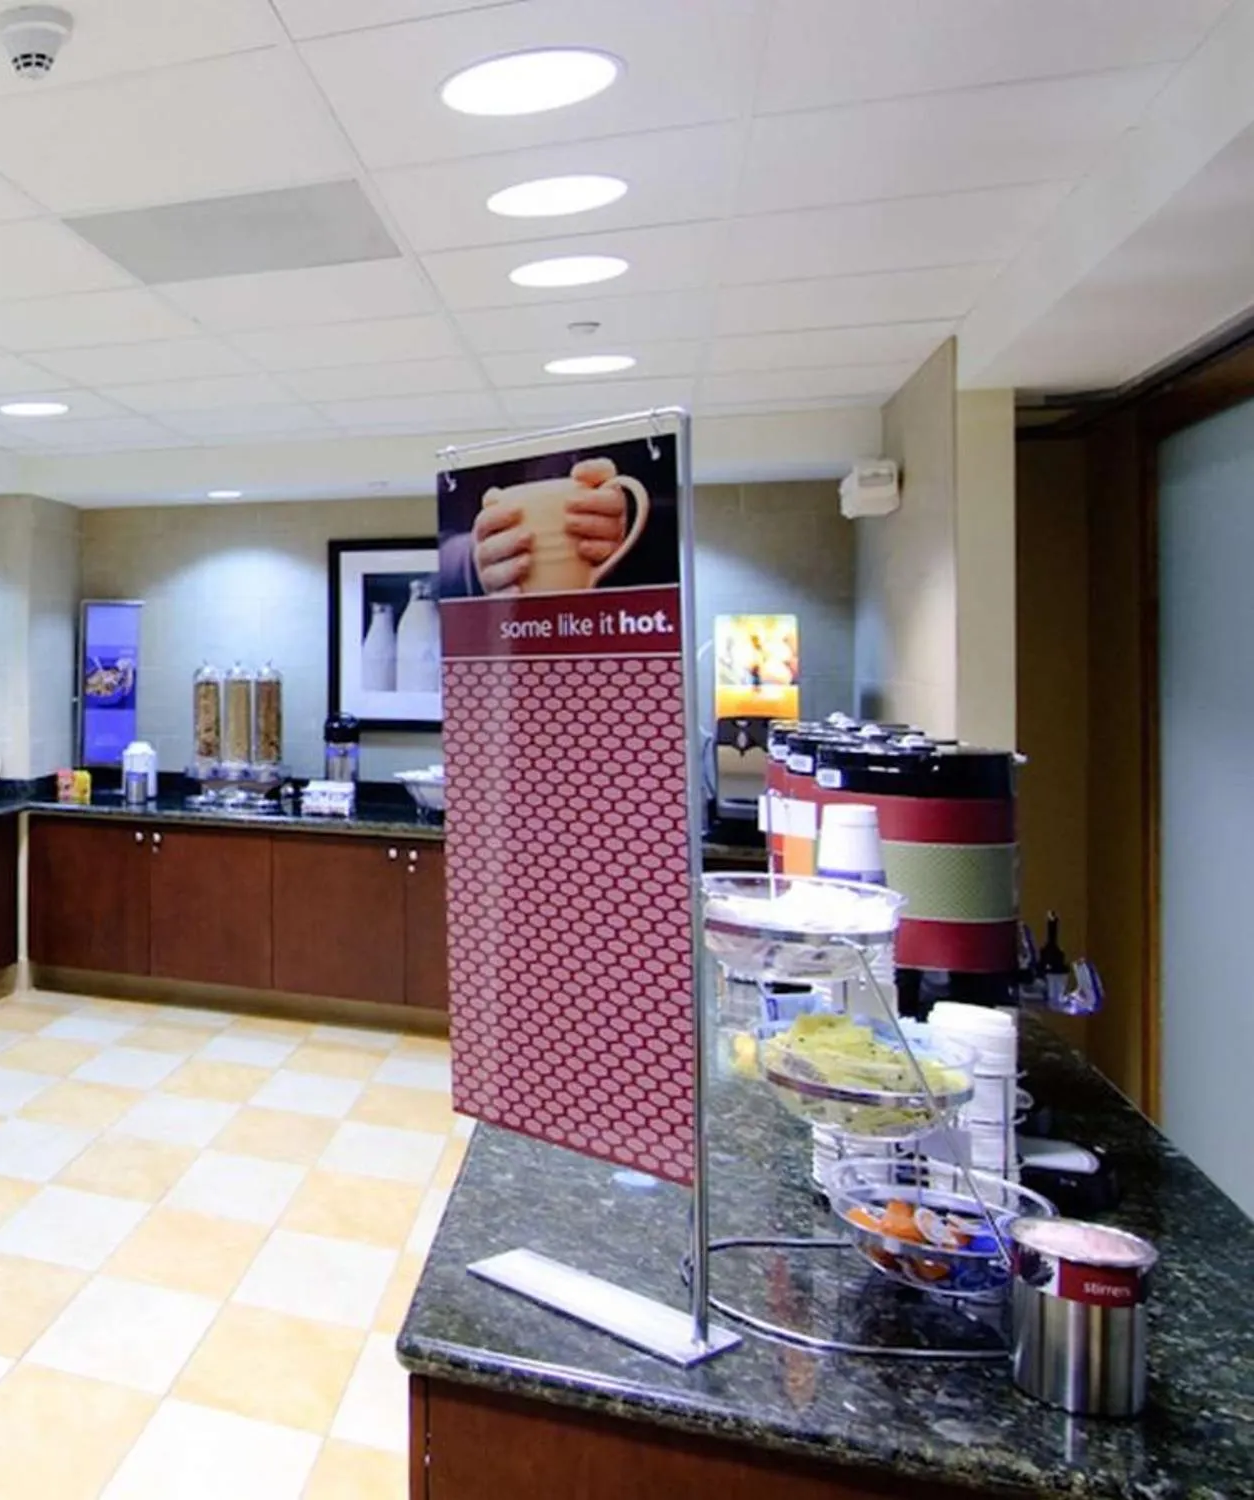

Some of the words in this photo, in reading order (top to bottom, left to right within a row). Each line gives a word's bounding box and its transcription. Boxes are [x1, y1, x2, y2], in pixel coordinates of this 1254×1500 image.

[499, 619, 552, 639] some
[557, 612, 594, 636] like
[599, 611, 615, 635] it
[618, 610, 674, 634] hot.
